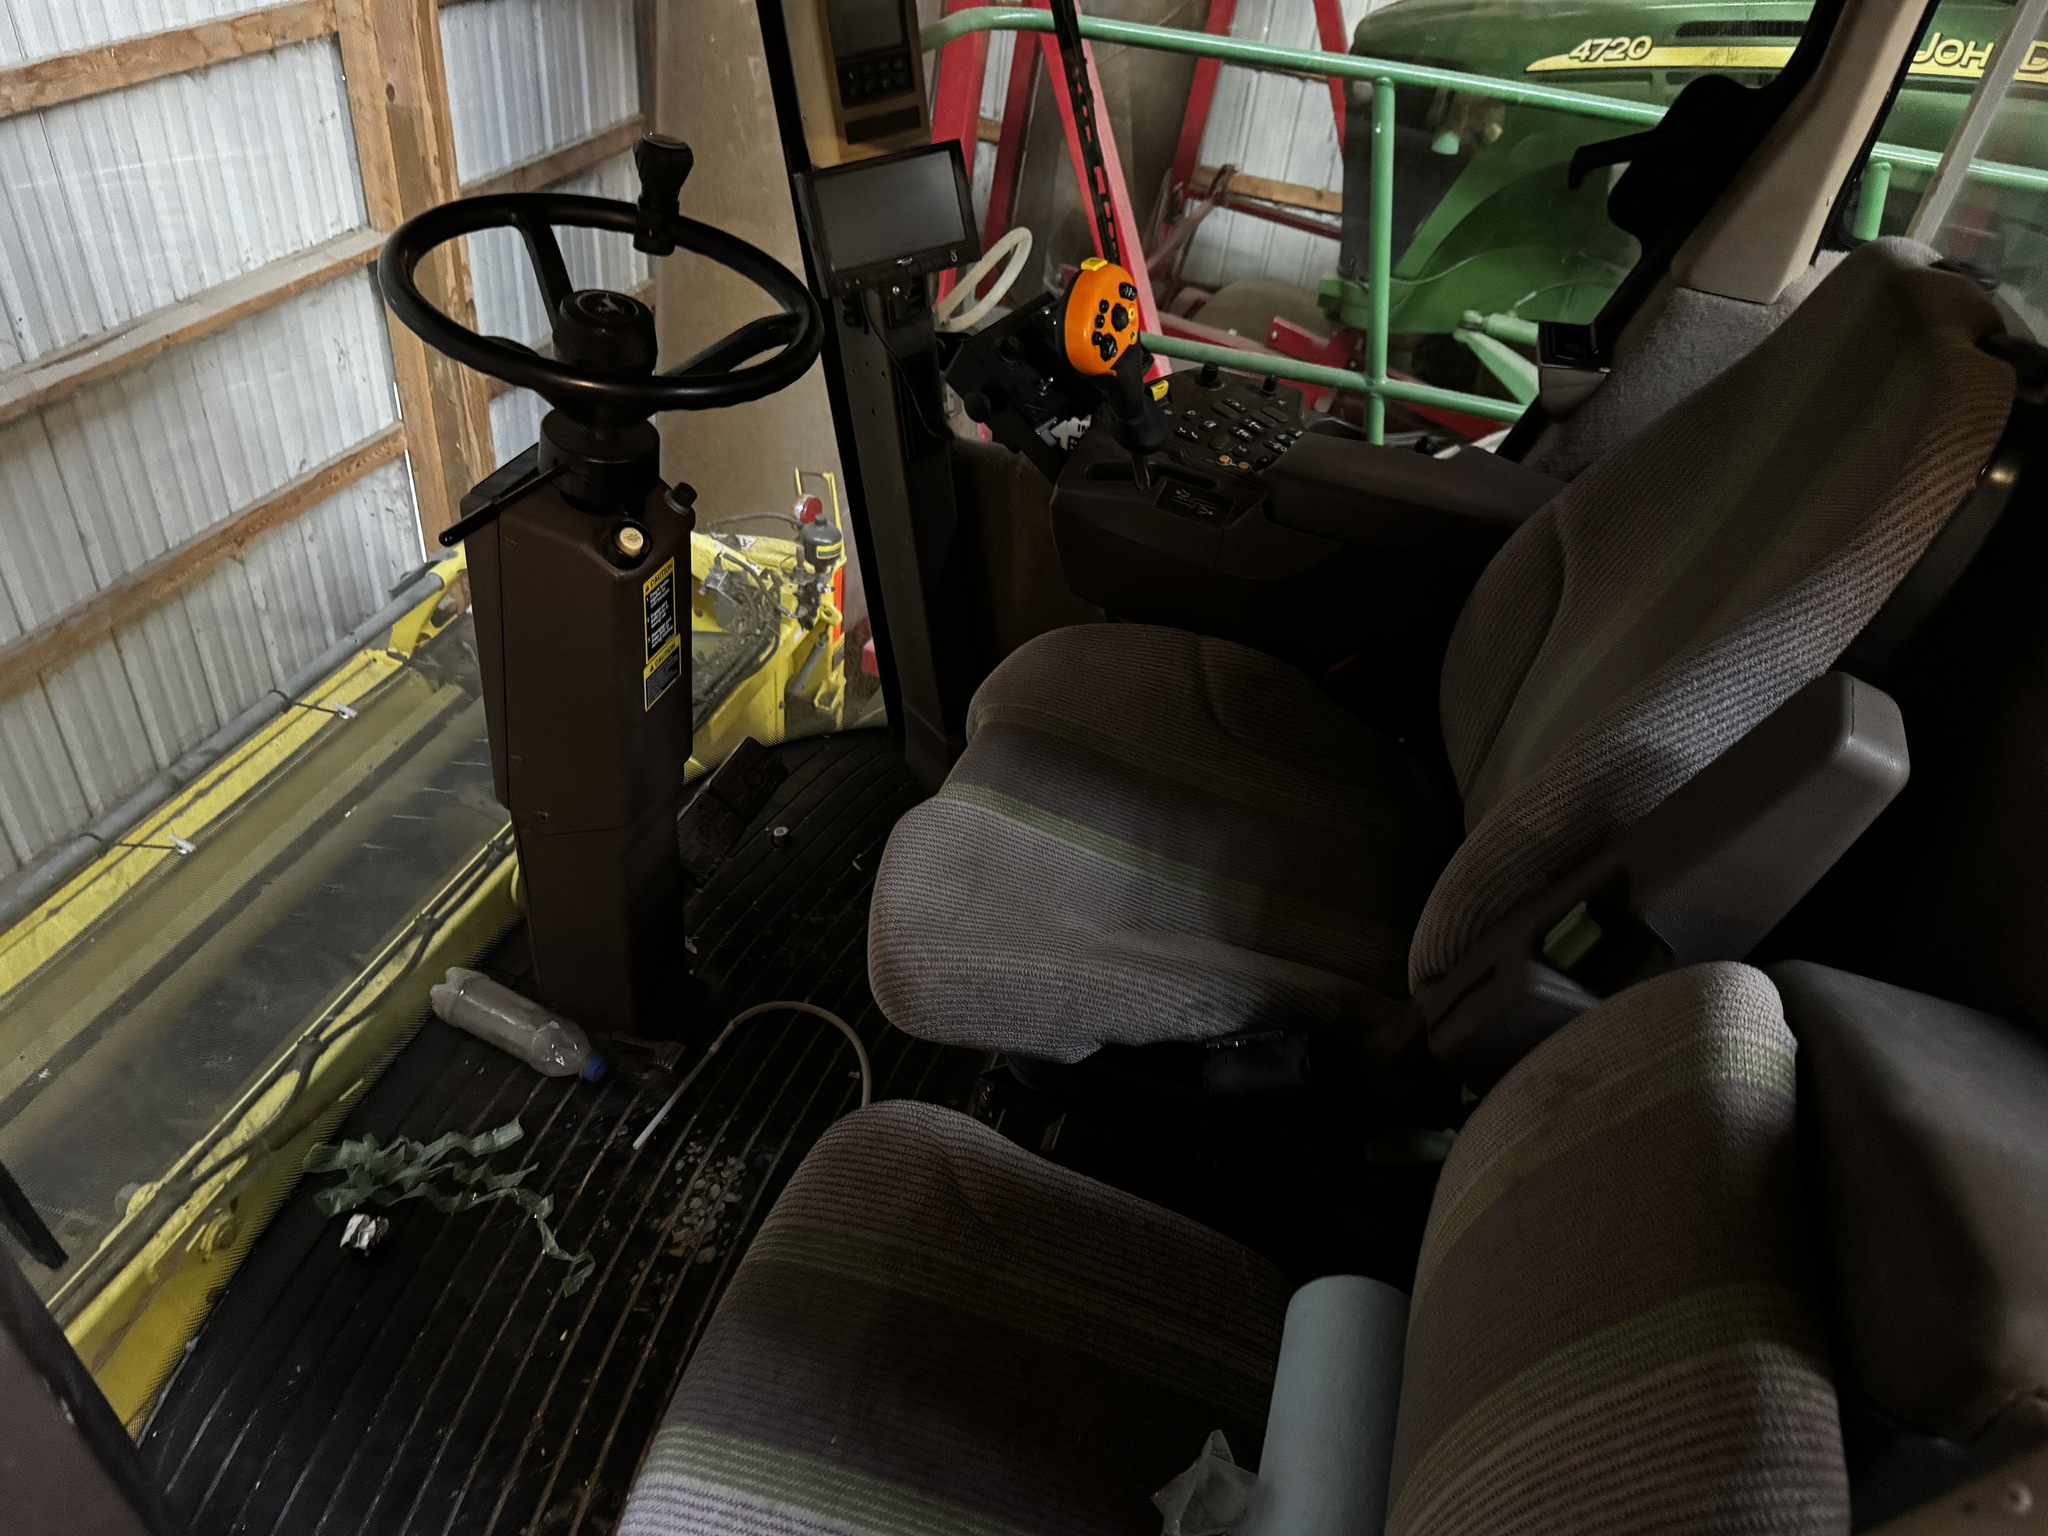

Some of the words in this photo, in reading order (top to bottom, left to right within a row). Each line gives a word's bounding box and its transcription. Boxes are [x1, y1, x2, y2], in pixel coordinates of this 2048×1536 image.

[1569, 35, 1653, 62] 4720
[1912, 32, 1995, 69] JOH
[650, 562, 673, 586] CAUTION
